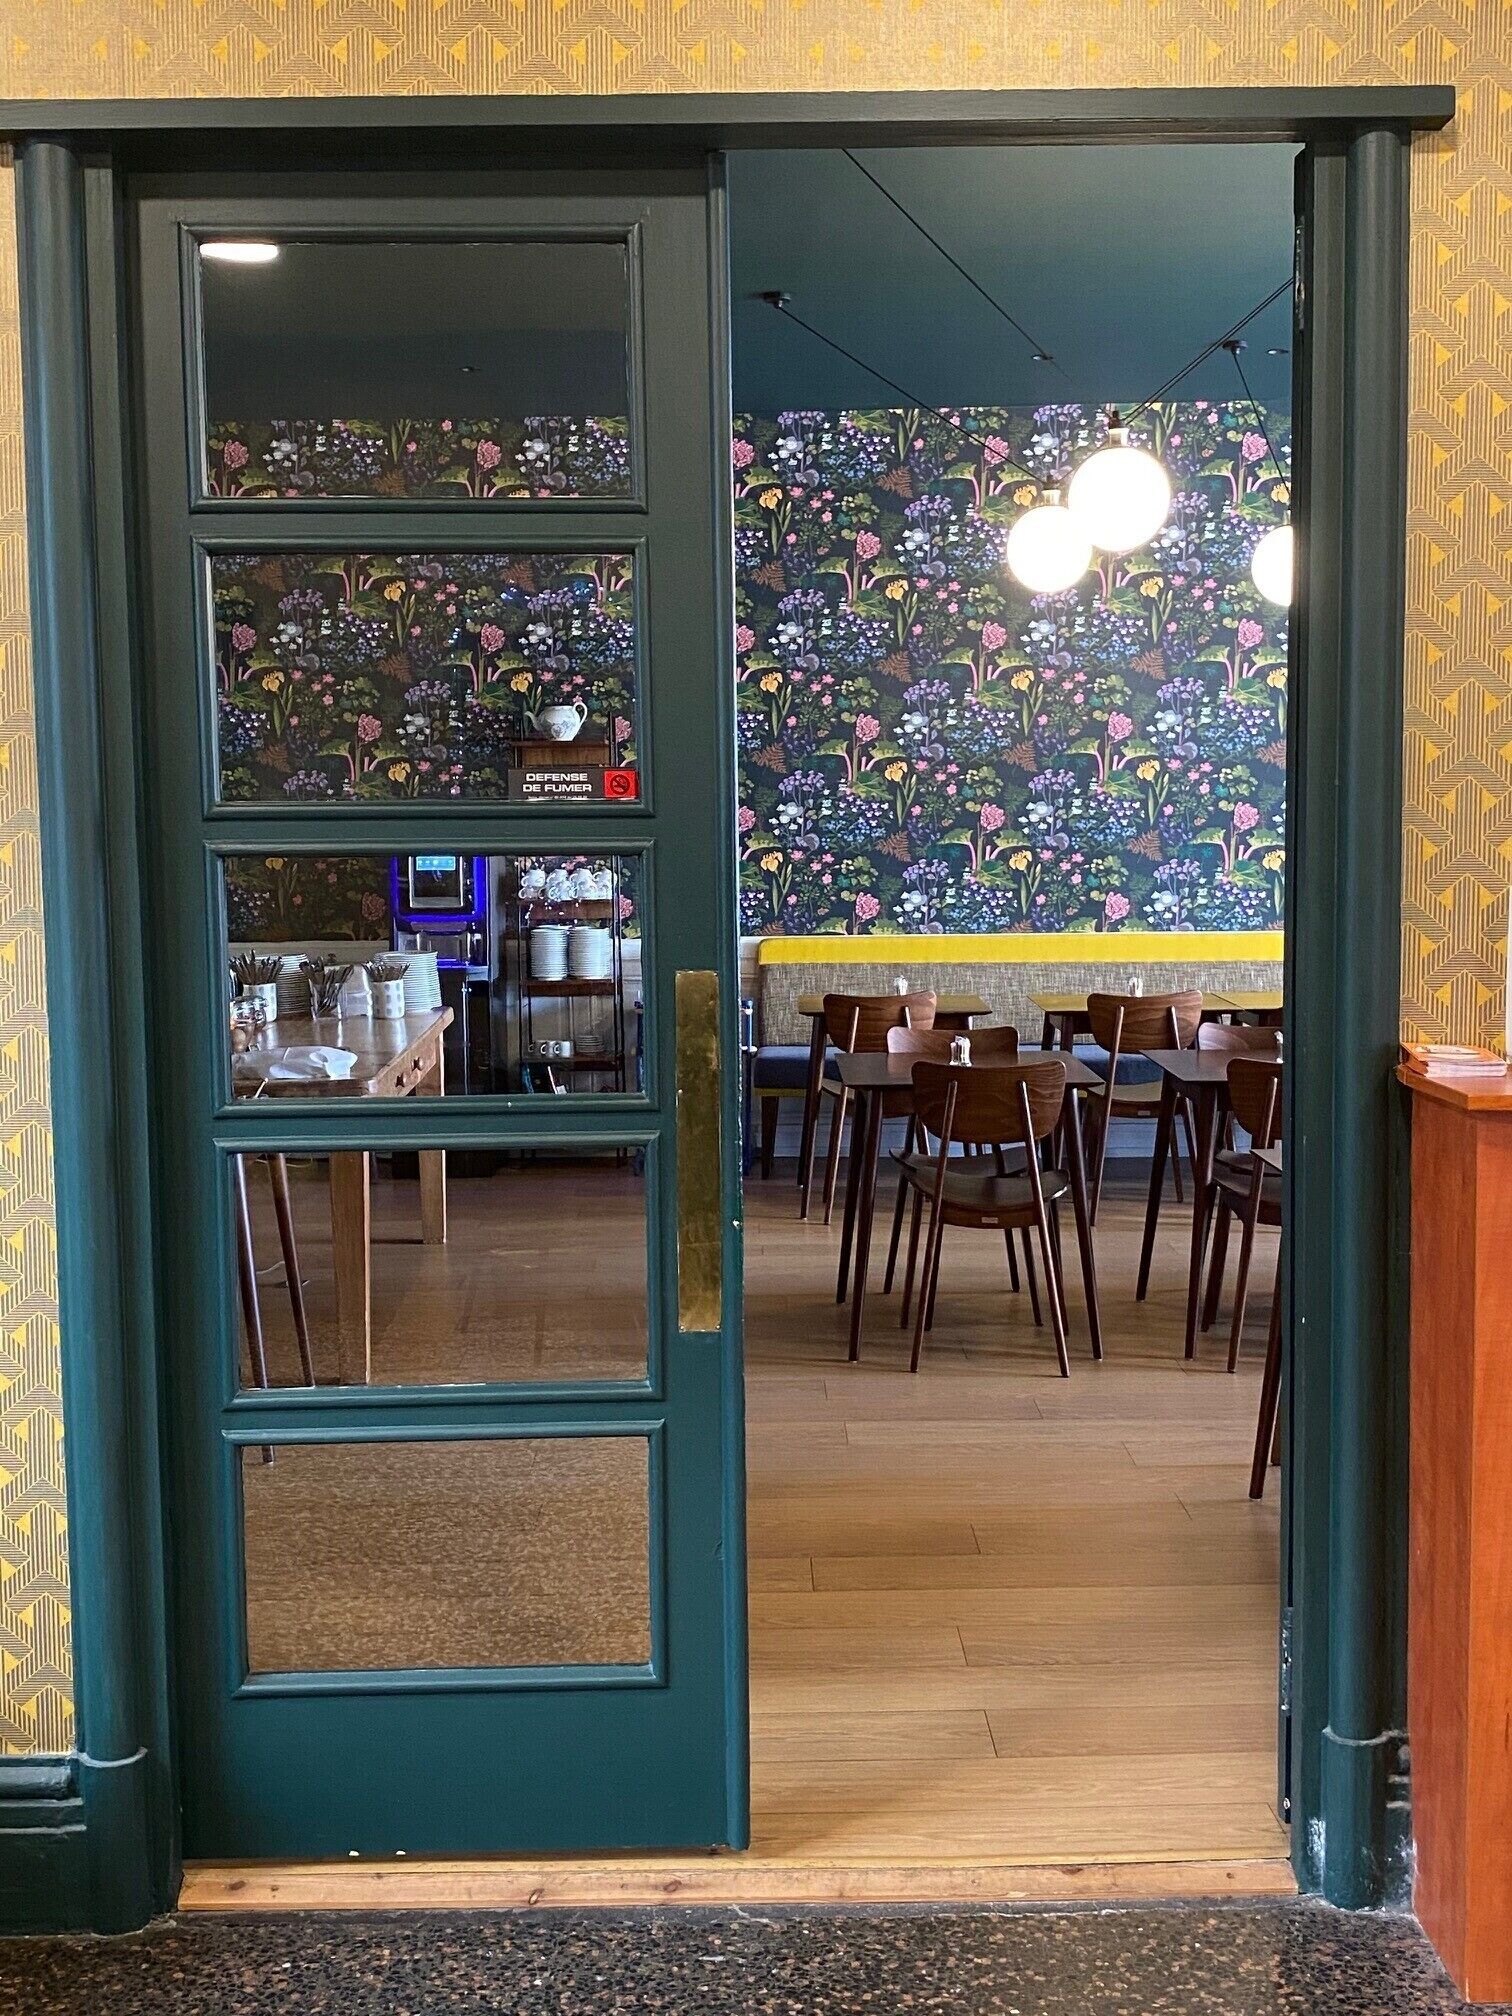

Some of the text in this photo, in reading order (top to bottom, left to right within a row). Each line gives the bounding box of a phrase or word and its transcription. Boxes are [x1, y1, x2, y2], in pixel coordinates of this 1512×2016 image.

[526, 773, 588, 781] DEFENSE
[522, 784, 592, 792] DE FUMER
